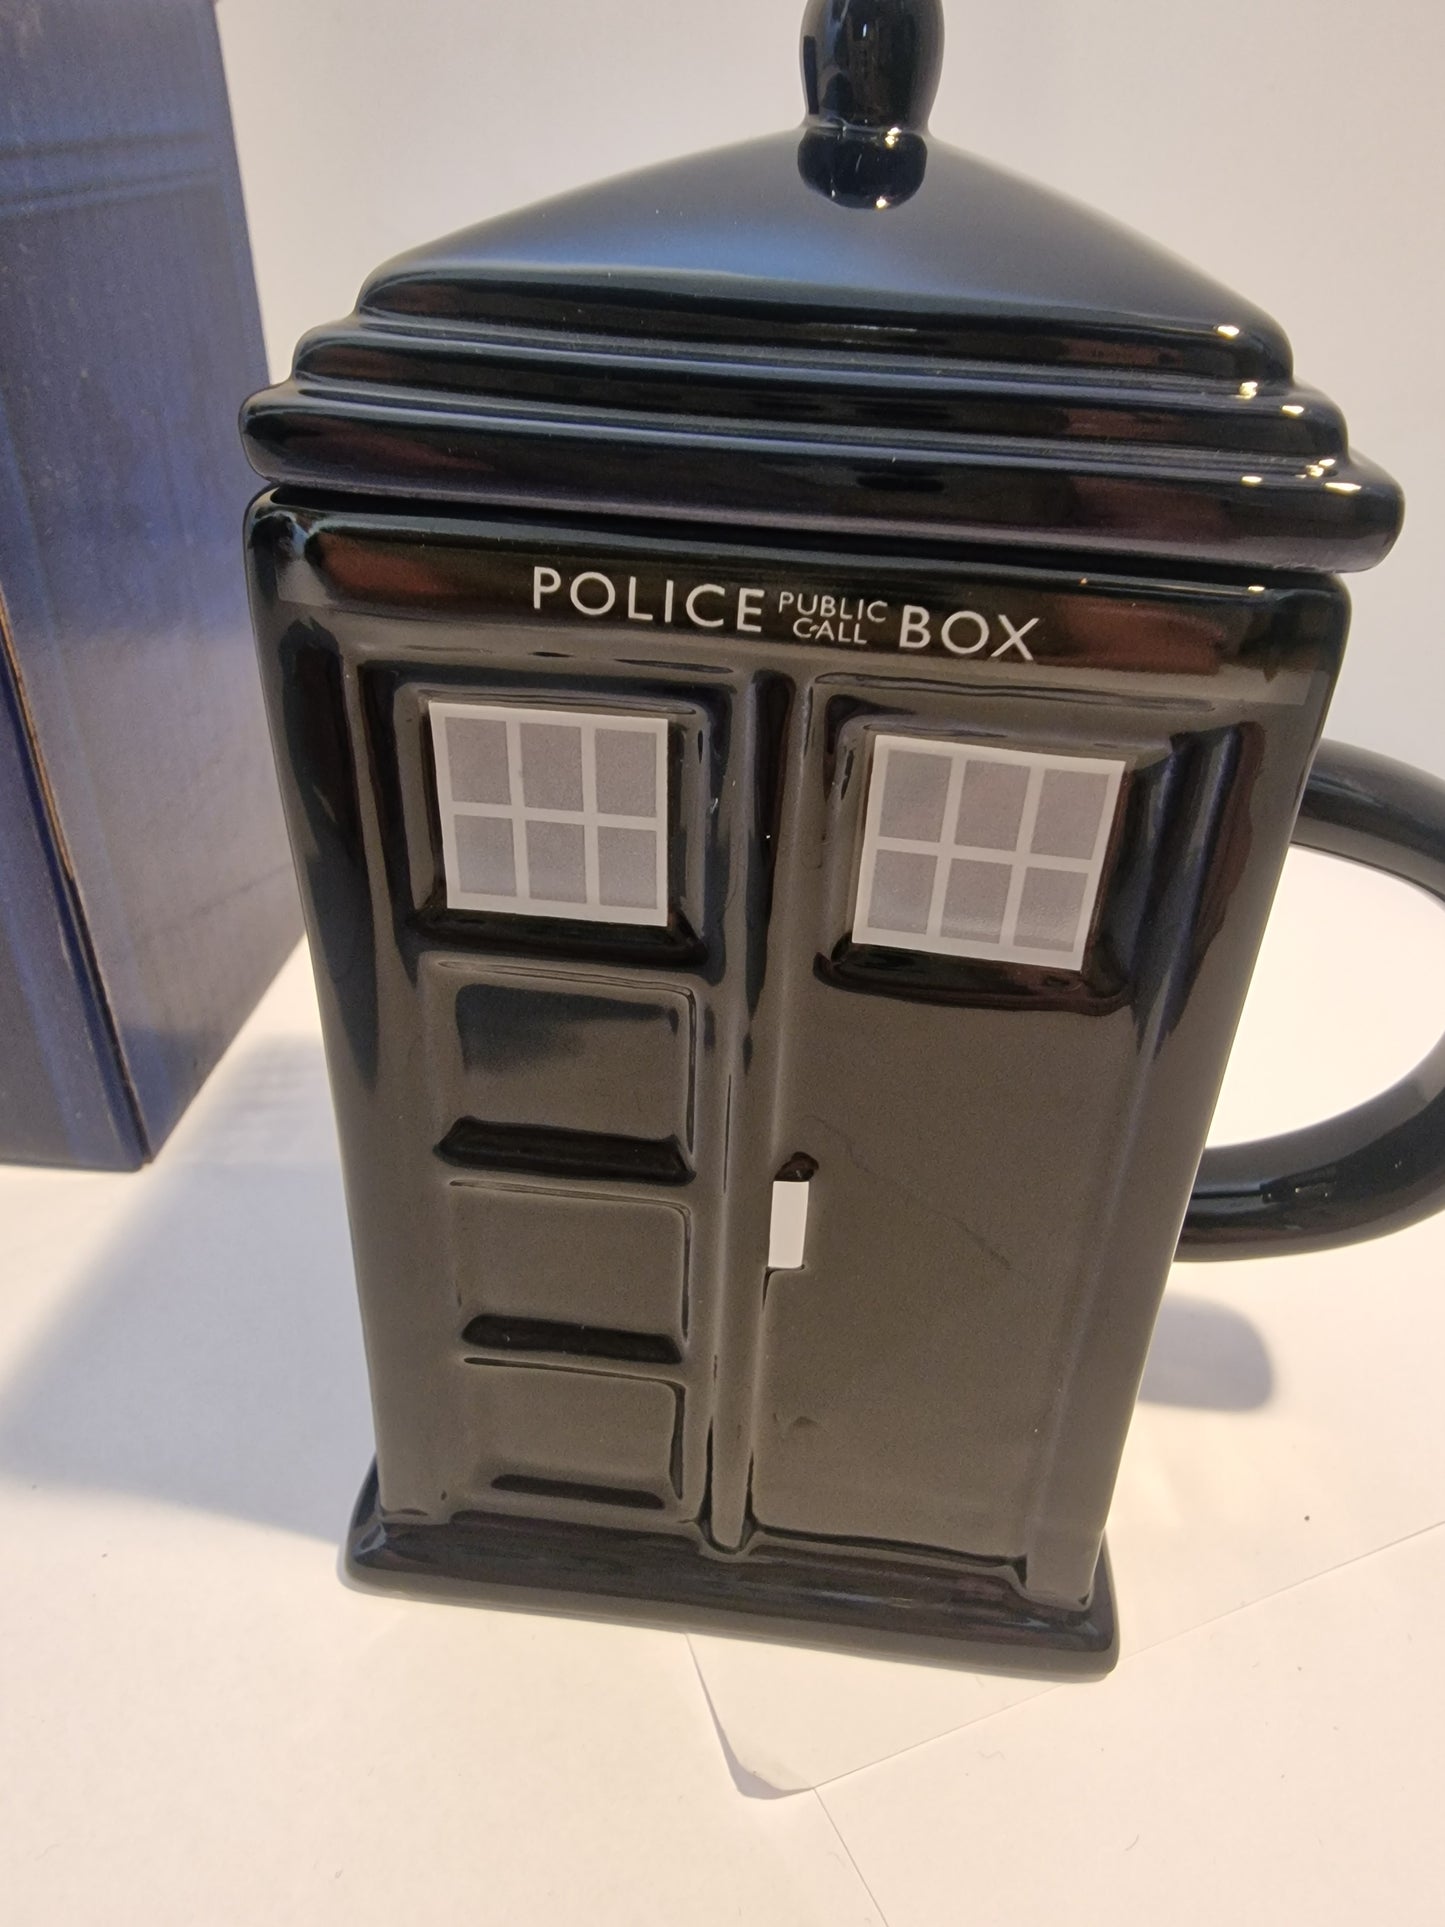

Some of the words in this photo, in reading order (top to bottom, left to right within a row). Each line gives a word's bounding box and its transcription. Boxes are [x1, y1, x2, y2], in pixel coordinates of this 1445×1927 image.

[533, 566, 765, 633] POLICE
[778, 591, 888, 623] PUBLIC
[792, 617, 868, 645] CALL
[899, 604, 1039, 661] BOX
